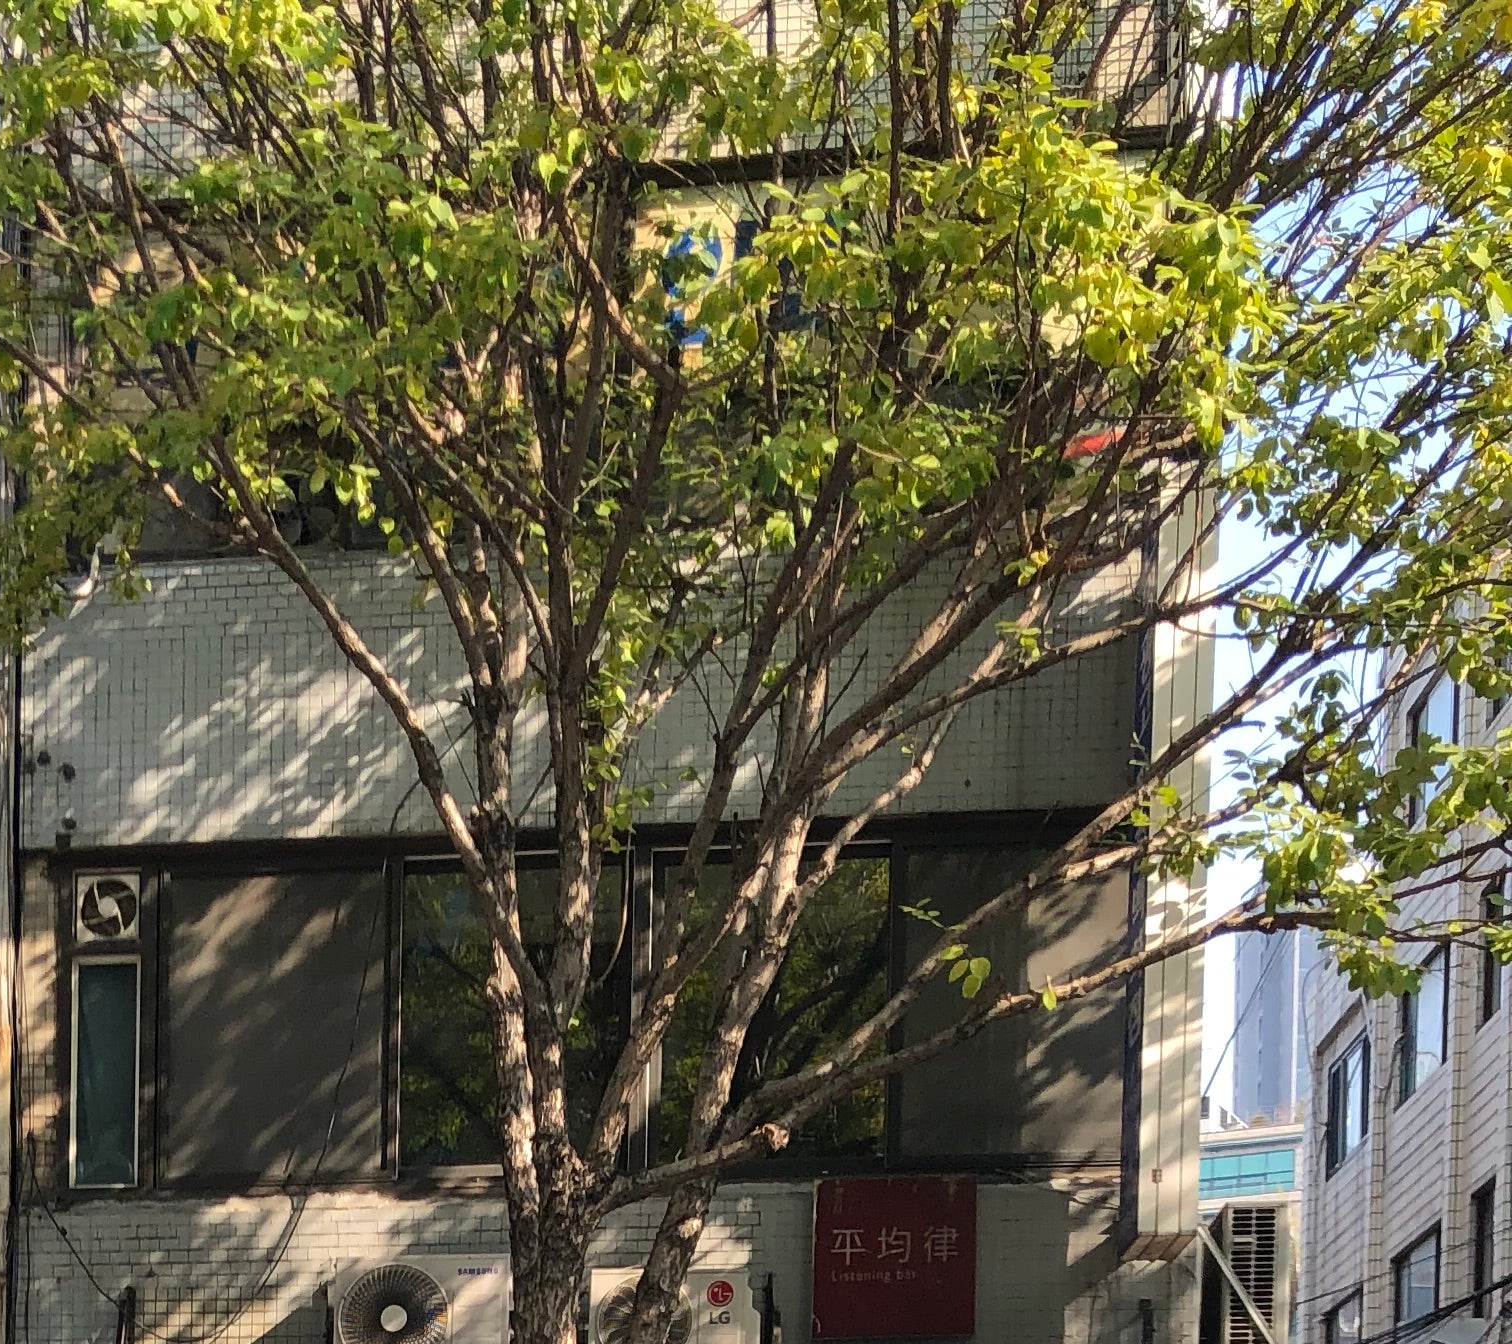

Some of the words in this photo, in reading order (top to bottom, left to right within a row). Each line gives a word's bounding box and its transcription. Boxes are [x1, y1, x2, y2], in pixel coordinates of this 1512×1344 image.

[830, 1224, 960, 1267] 平均律
[709, 1311, 731, 1325] LG
